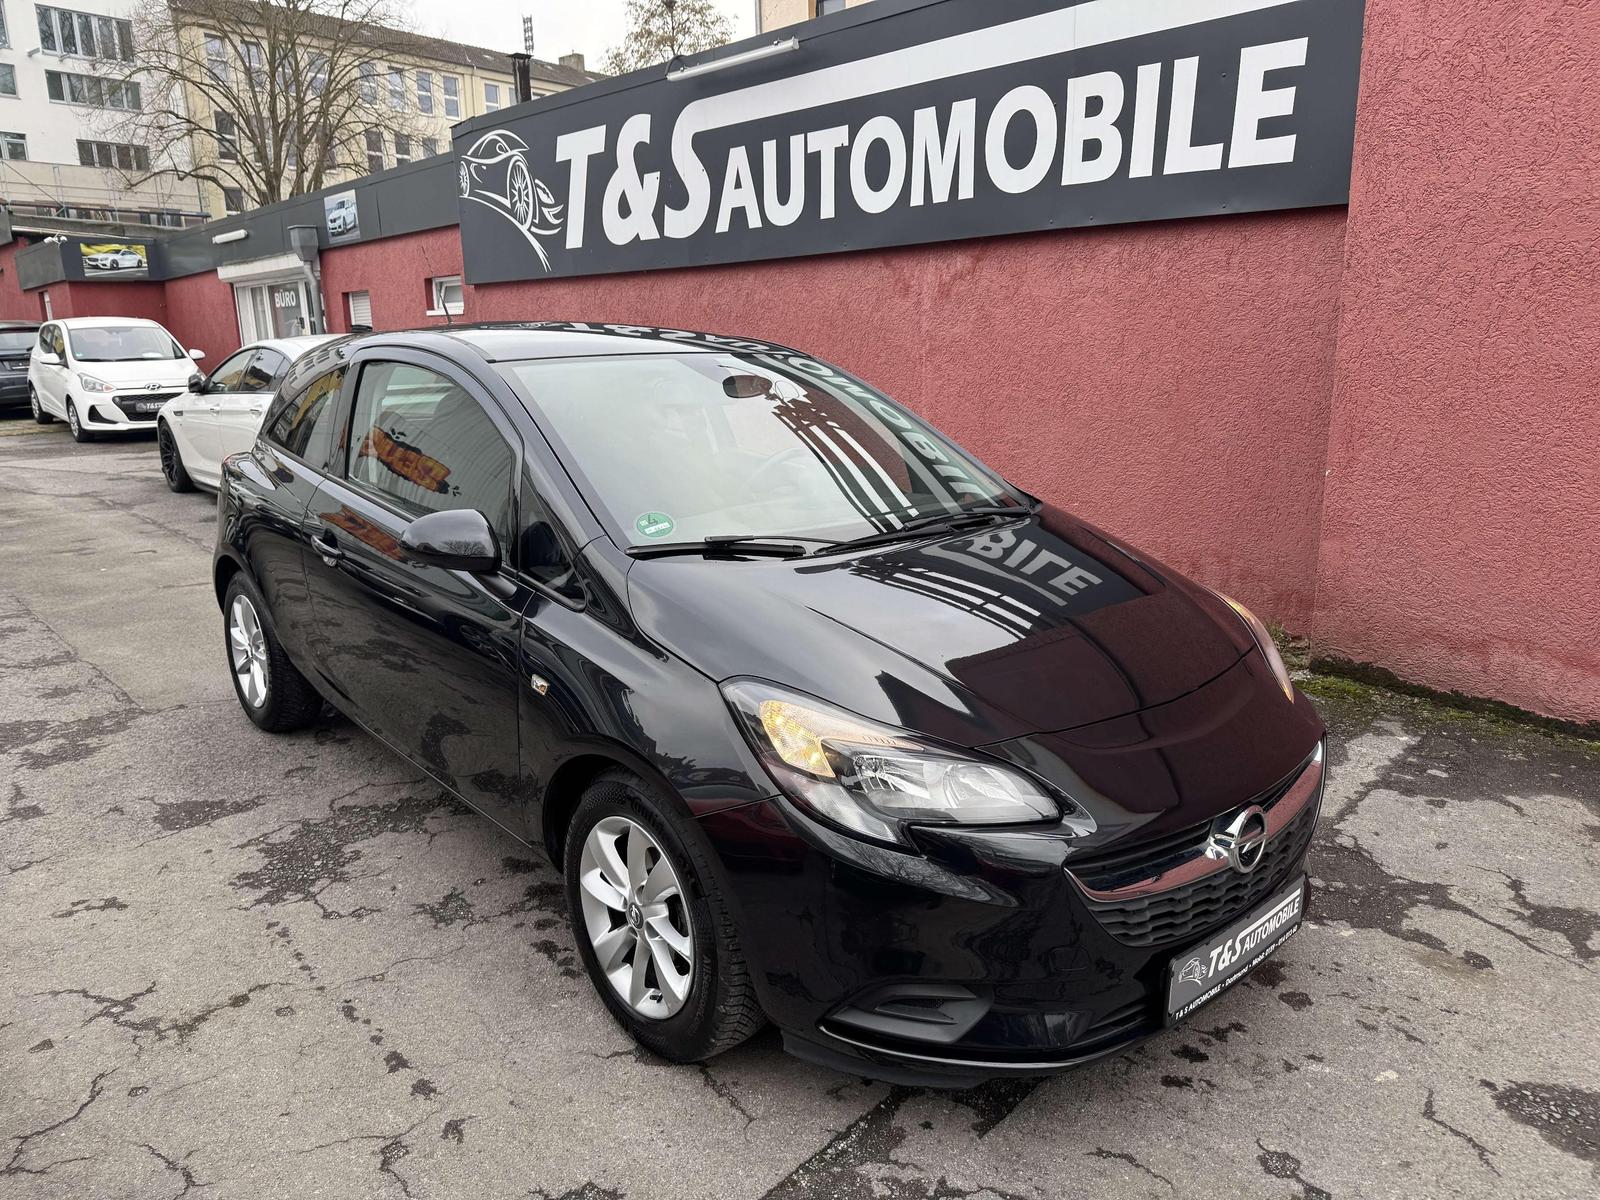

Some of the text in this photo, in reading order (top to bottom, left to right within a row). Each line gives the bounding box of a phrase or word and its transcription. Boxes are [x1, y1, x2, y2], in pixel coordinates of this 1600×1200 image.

[554, 36, 1310, 250] T&S AUTOMOBILE
[274, 289, 297, 308] BÜRO
[1208, 897, 1299, 978] T&S AUTOMOBILE
[1188, 983, 1221, 1012] AUTOMOBILE
